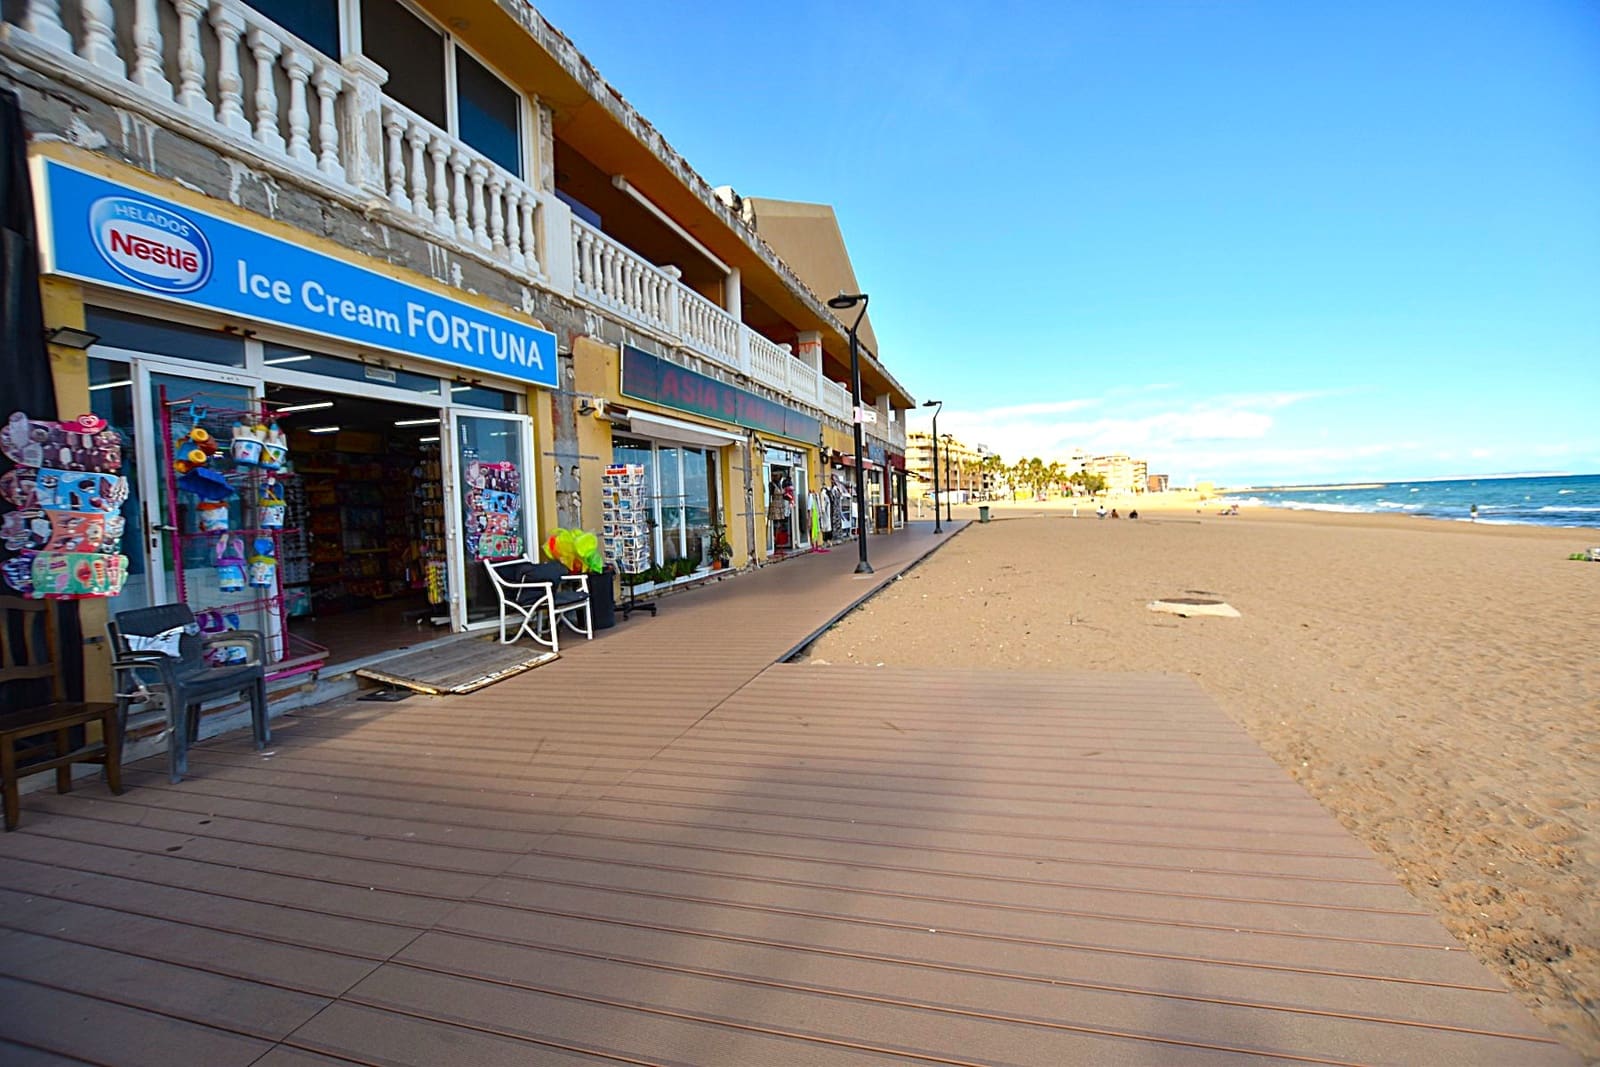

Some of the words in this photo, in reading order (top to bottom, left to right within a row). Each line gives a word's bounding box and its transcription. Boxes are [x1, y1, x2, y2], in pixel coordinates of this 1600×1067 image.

[114, 204, 190, 237] HELADOS
[110, 229, 199, 273] Nestlé
[237, 259, 292, 305] Ice
[301, 280, 401, 335] Cream
[406, 302, 544, 371] FORTUNA
[661, 369, 718, 410] ASIA
